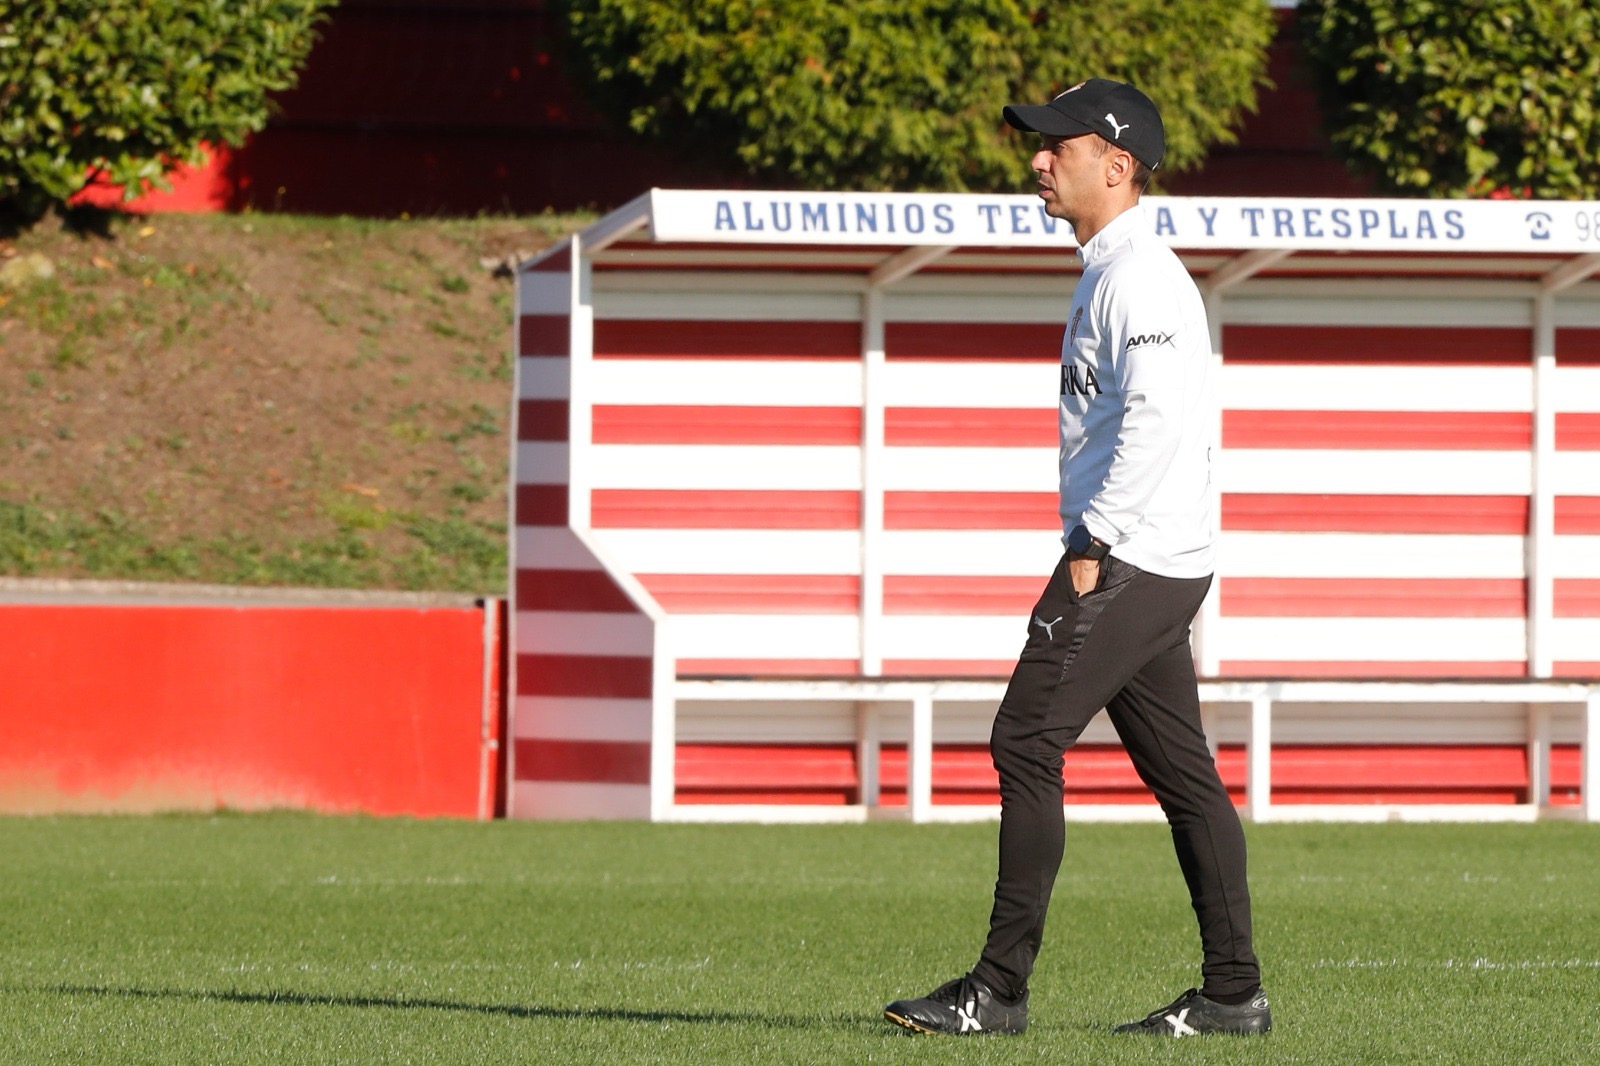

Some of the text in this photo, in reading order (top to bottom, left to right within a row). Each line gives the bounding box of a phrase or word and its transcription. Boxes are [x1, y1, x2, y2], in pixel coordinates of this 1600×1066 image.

[714, 200, 955, 234] ALUMINIOS
[977, 204, 1177, 236] TEVA
[1197, 207, 1218, 236] Y
[1240, 207, 1466, 240] TRESPLAS
[1125, 330, 1178, 350] AMIX
